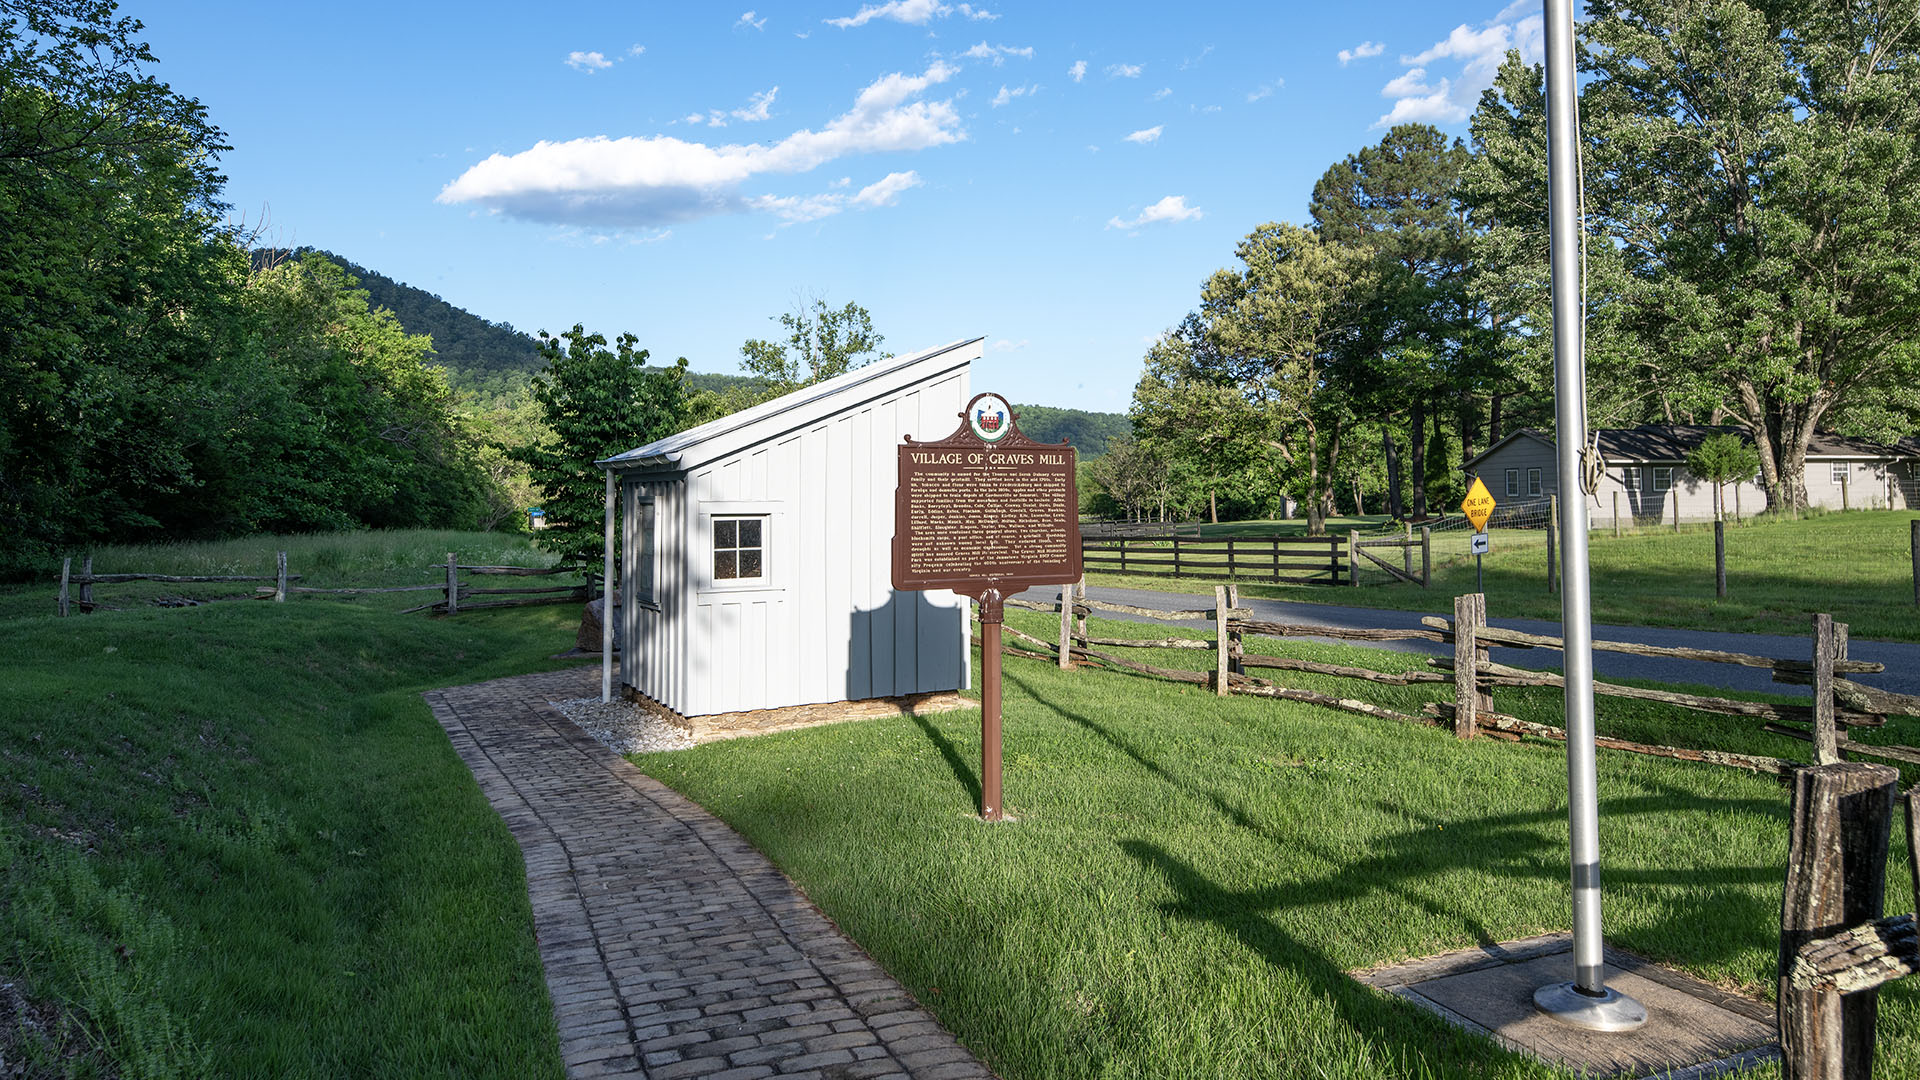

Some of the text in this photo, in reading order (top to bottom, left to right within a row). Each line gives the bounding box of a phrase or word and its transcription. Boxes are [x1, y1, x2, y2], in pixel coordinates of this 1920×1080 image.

[911, 453, 1066, 465] VILLAGE OF GRAVES MILL
[1467, 496, 1490, 507] ONE LANE
[1471, 508, 1487, 517] BRIDGE
